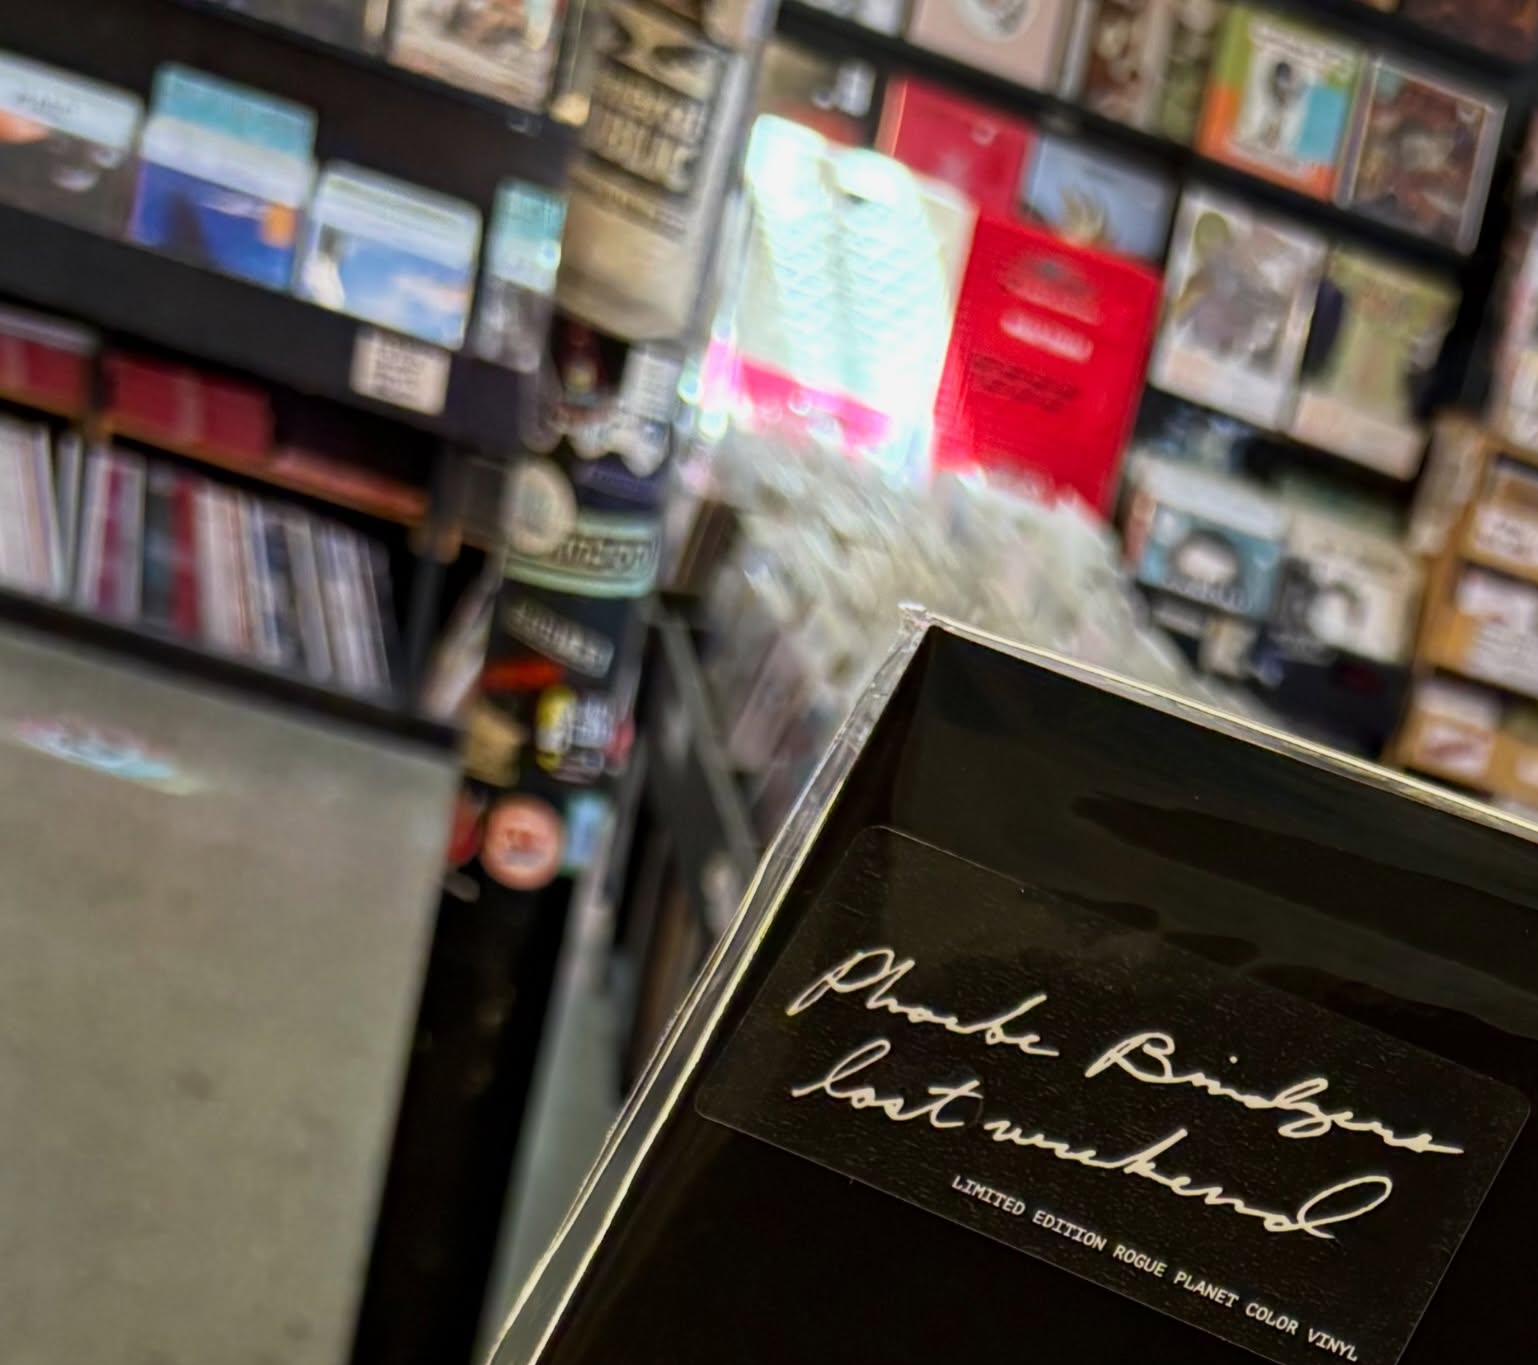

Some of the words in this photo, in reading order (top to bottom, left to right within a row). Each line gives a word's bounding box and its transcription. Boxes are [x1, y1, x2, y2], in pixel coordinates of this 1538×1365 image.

[785, 946, 1060, 1057] Phoebe
[1084, 1031, 1465, 1156] Bridgers
[951, 1175, 1026, 1216] LIMITED
[1031, 1209, 1108, 1252] EDITION
[1112, 1243, 1168, 1278] ROGUE
[1173, 1269, 1240, 1308] PLANET
[1245, 1301, 1299, 1336] COLOR
[1307, 1327, 1358, 1362] VINYL
